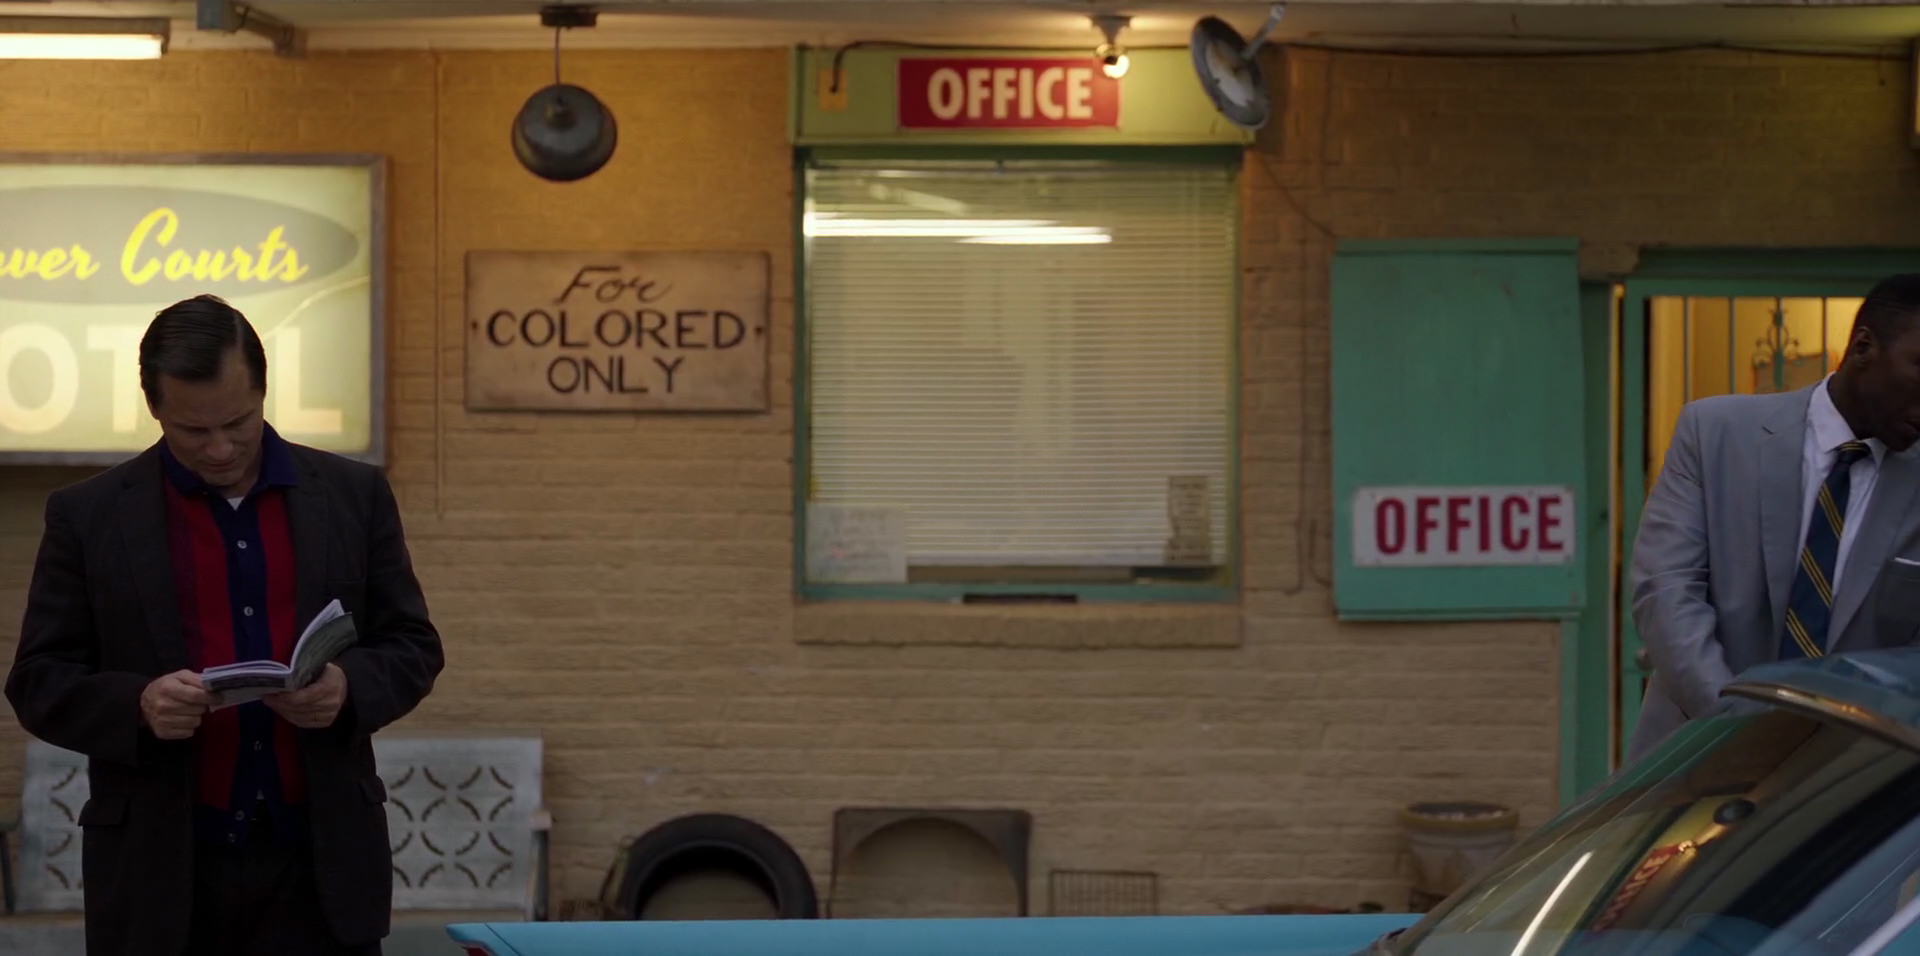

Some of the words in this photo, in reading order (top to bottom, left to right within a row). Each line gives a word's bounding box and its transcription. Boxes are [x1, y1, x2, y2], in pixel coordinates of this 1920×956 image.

[927, 67, 1093, 120] OFFICE
[121, 207, 309, 286] Courts
[553, 264, 672, 304] For
[486, 308, 746, 349] COLORED
[0, 322, 342, 434] OTL
[547, 355, 685, 394] ONLY
[1376, 496, 1563, 555] OFFICE
